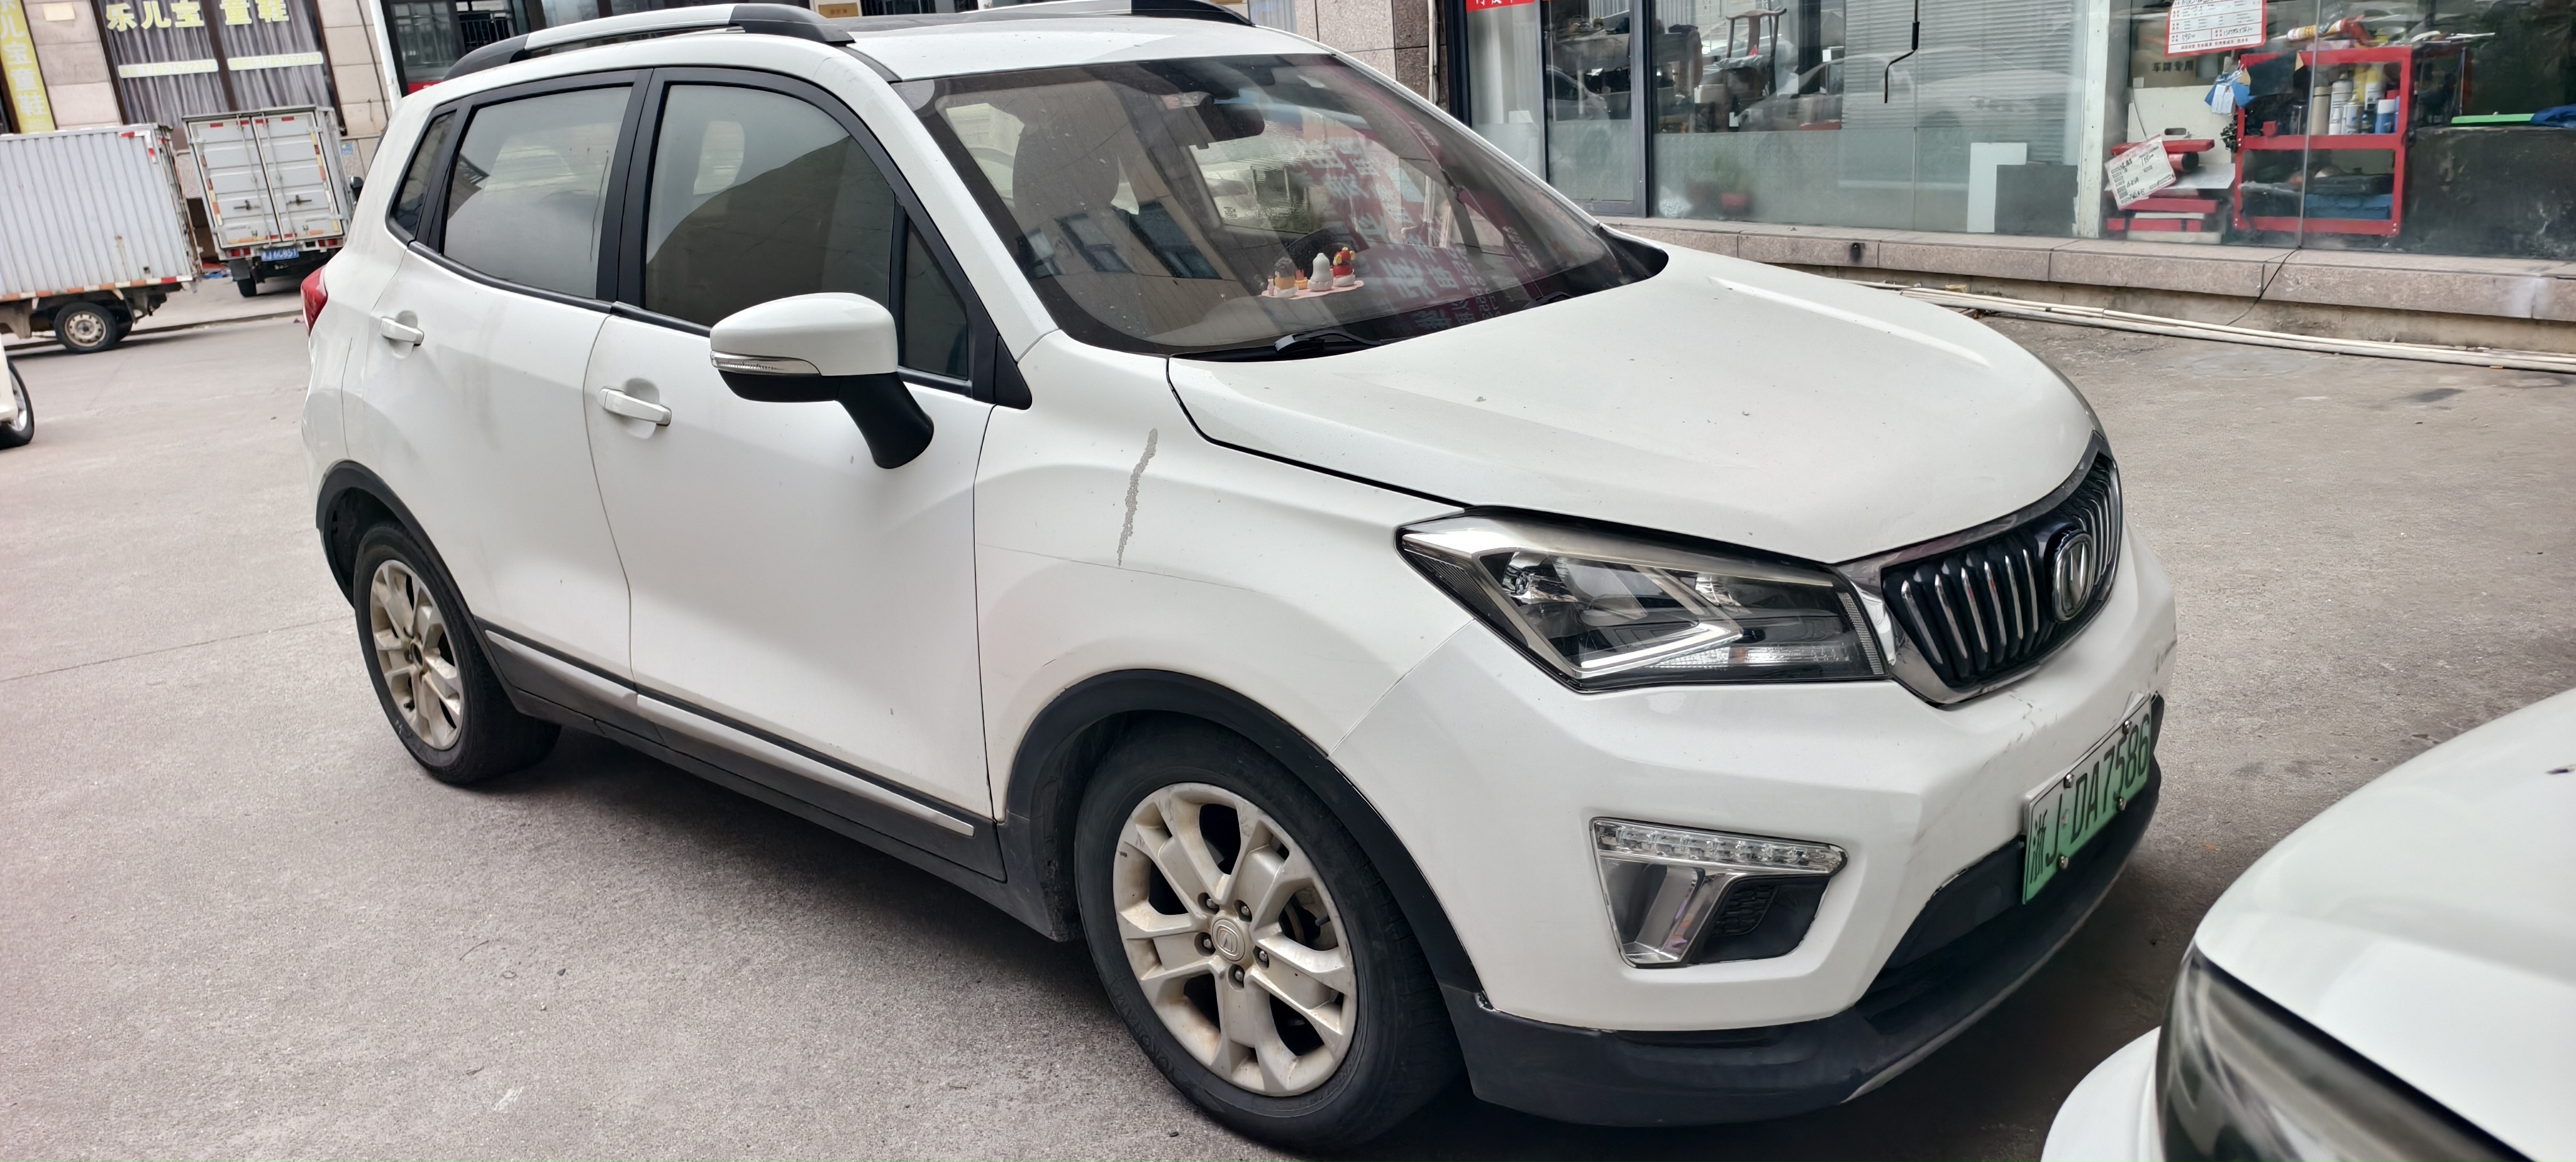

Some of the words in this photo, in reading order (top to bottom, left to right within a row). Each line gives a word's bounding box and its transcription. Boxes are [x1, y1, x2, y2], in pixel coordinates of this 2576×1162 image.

[106, 0, 204, 31] 乐儿宝
[220, 0, 290, 26] 童鞋
